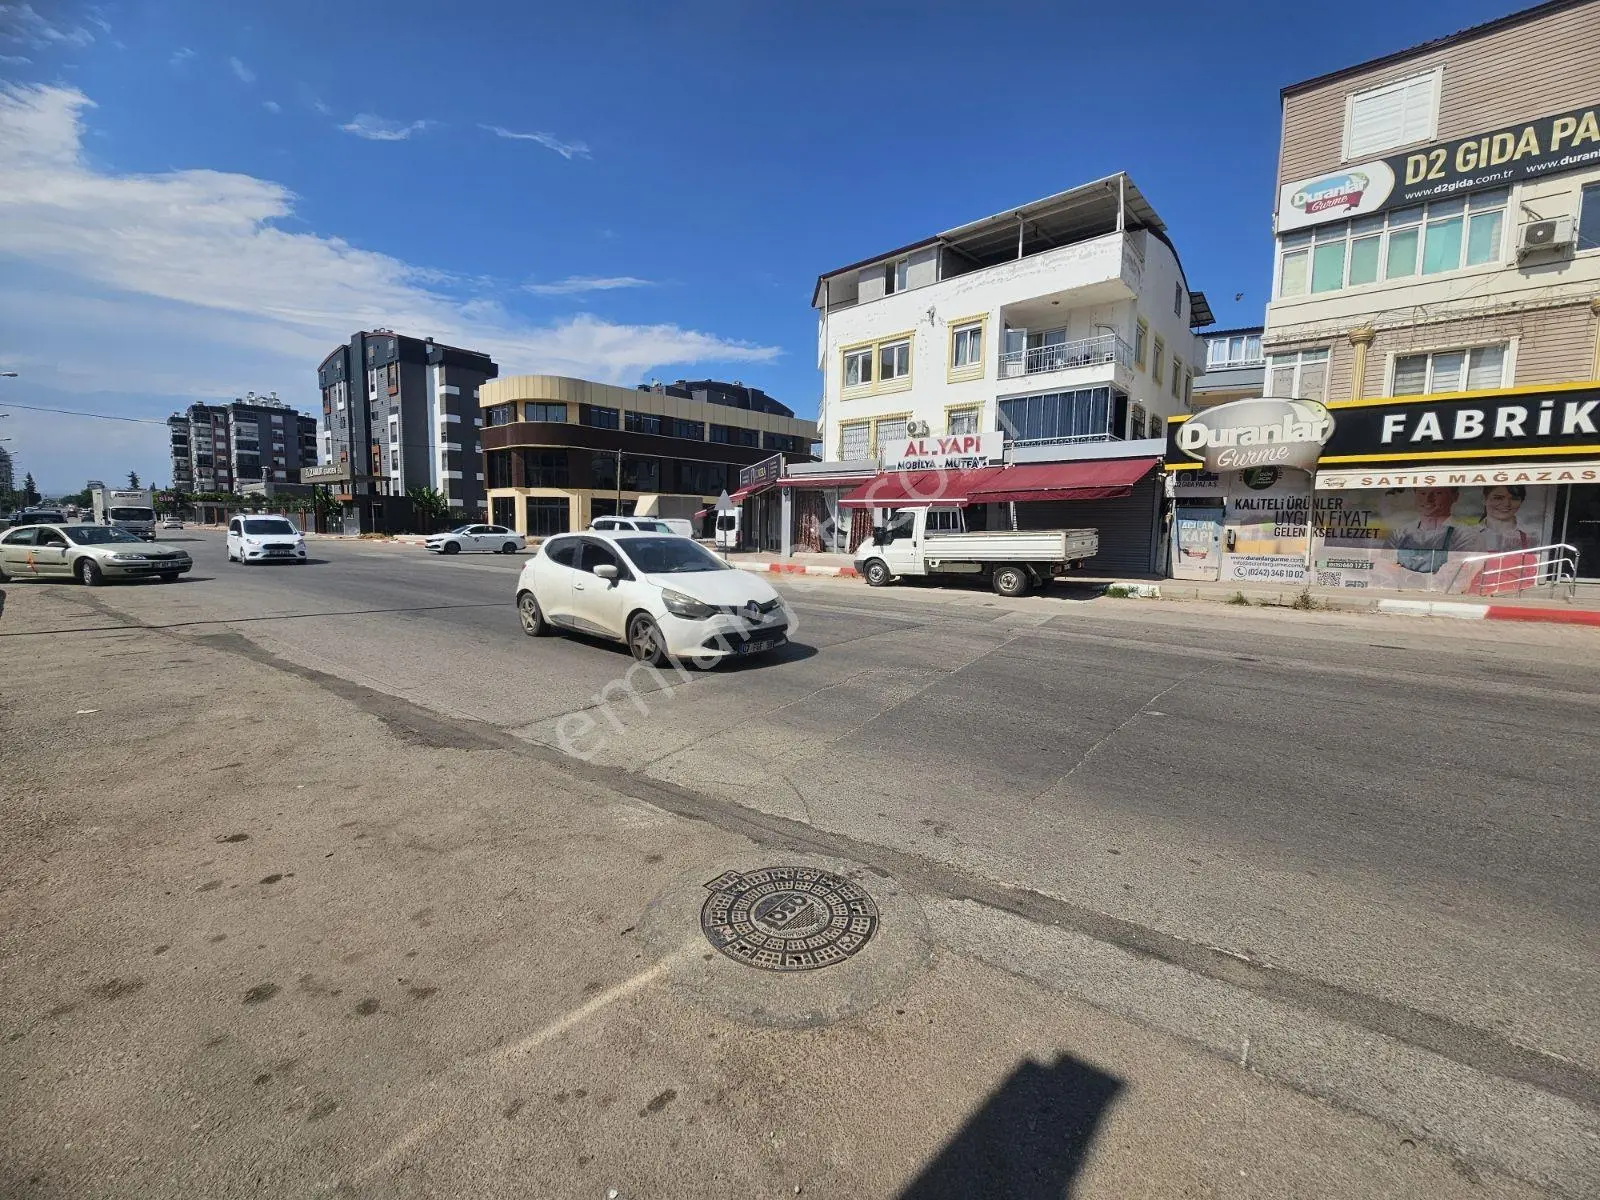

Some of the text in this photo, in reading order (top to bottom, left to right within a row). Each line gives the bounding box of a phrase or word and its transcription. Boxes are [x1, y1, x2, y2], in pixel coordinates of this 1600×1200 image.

[1404, 110, 1600, 186] D2 GIDA PA
[1294, 178, 1367, 207] Duranlar
[1404, 168, 1514, 200] www.d2gida.com.tr
[1311, 195, 1349, 212] Gurme
[1181, 413, 1330, 450] Duranlar
[1217, 446, 1290, 468] Gurme
[1360, 475, 1437, 486] SATIŞ
[1286, 496, 1344, 510] ÜRÜNLER
[1340, 528, 1379, 539] LEZZET
[1247, 568, 1270, 578] (0242)
[1271, 569, 1285, 577] 346
[1294, 571, 1304, 579] 02
